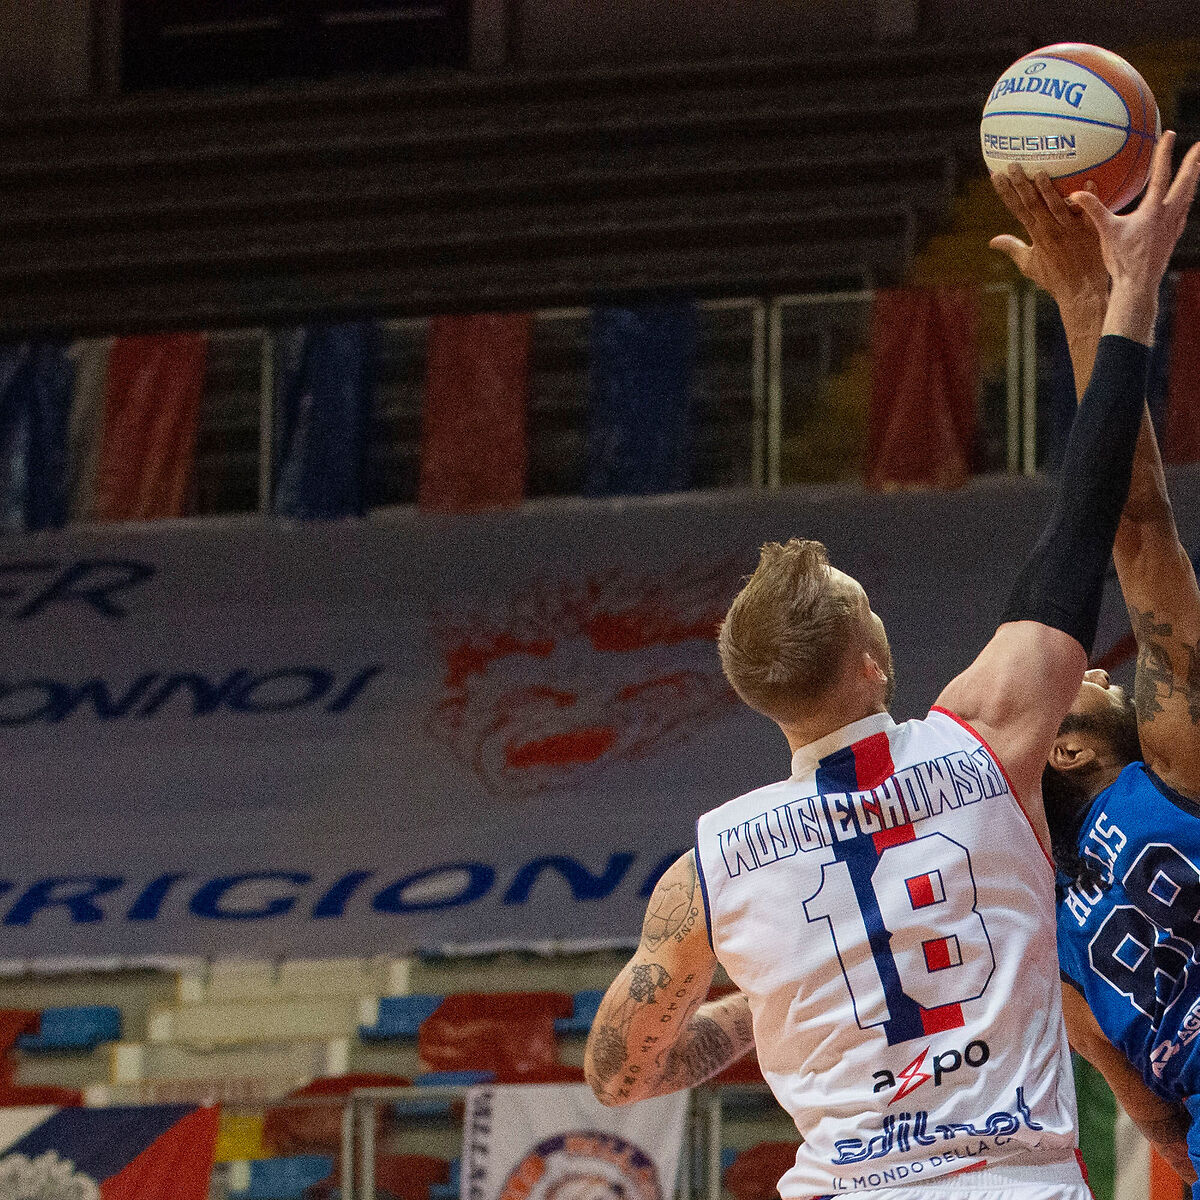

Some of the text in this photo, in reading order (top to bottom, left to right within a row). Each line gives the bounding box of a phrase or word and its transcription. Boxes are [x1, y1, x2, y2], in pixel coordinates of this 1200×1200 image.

[984, 134, 1076, 151] PRECISION
[0, 852, 692, 925] RIGION
[802, 832, 996, 1031] 18
[832, 1178, 847, 1190] IL
[853, 1161, 924, 1188] MONDO
[930, 1140, 990, 1167] DELLA
